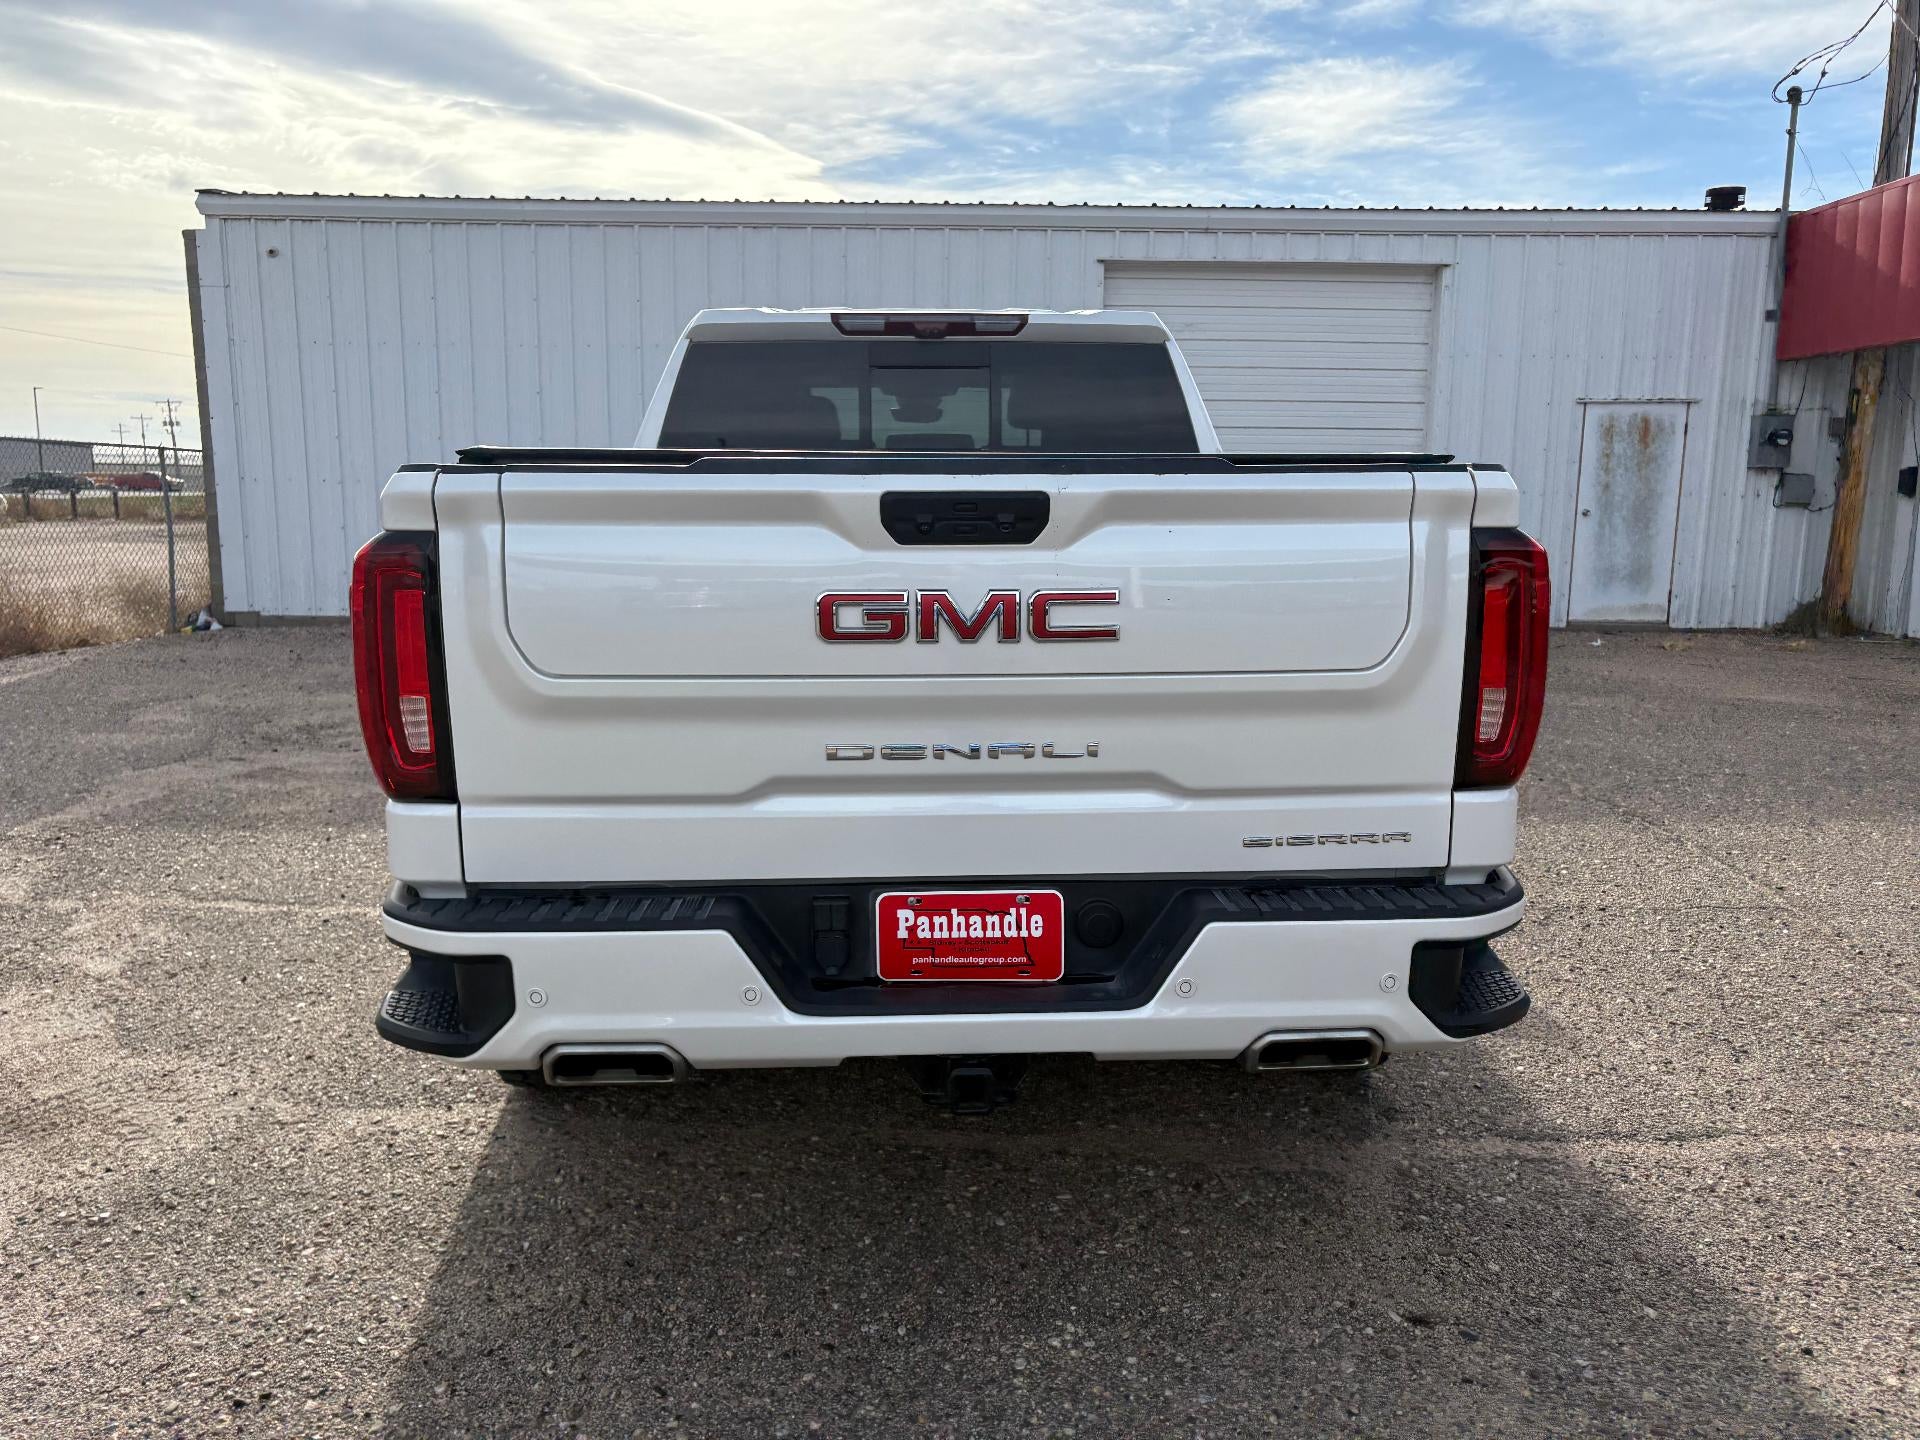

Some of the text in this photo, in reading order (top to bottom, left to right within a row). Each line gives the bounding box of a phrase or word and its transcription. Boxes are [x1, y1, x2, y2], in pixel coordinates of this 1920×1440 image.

[815, 589, 1120, 643] GMC
[825, 741, 1099, 760] DENALI
[1243, 832, 1412, 847] SIERRA
[896, 907, 1044, 939] Panhandle
[912, 955, 1027, 965] panhandleautogroup.com
